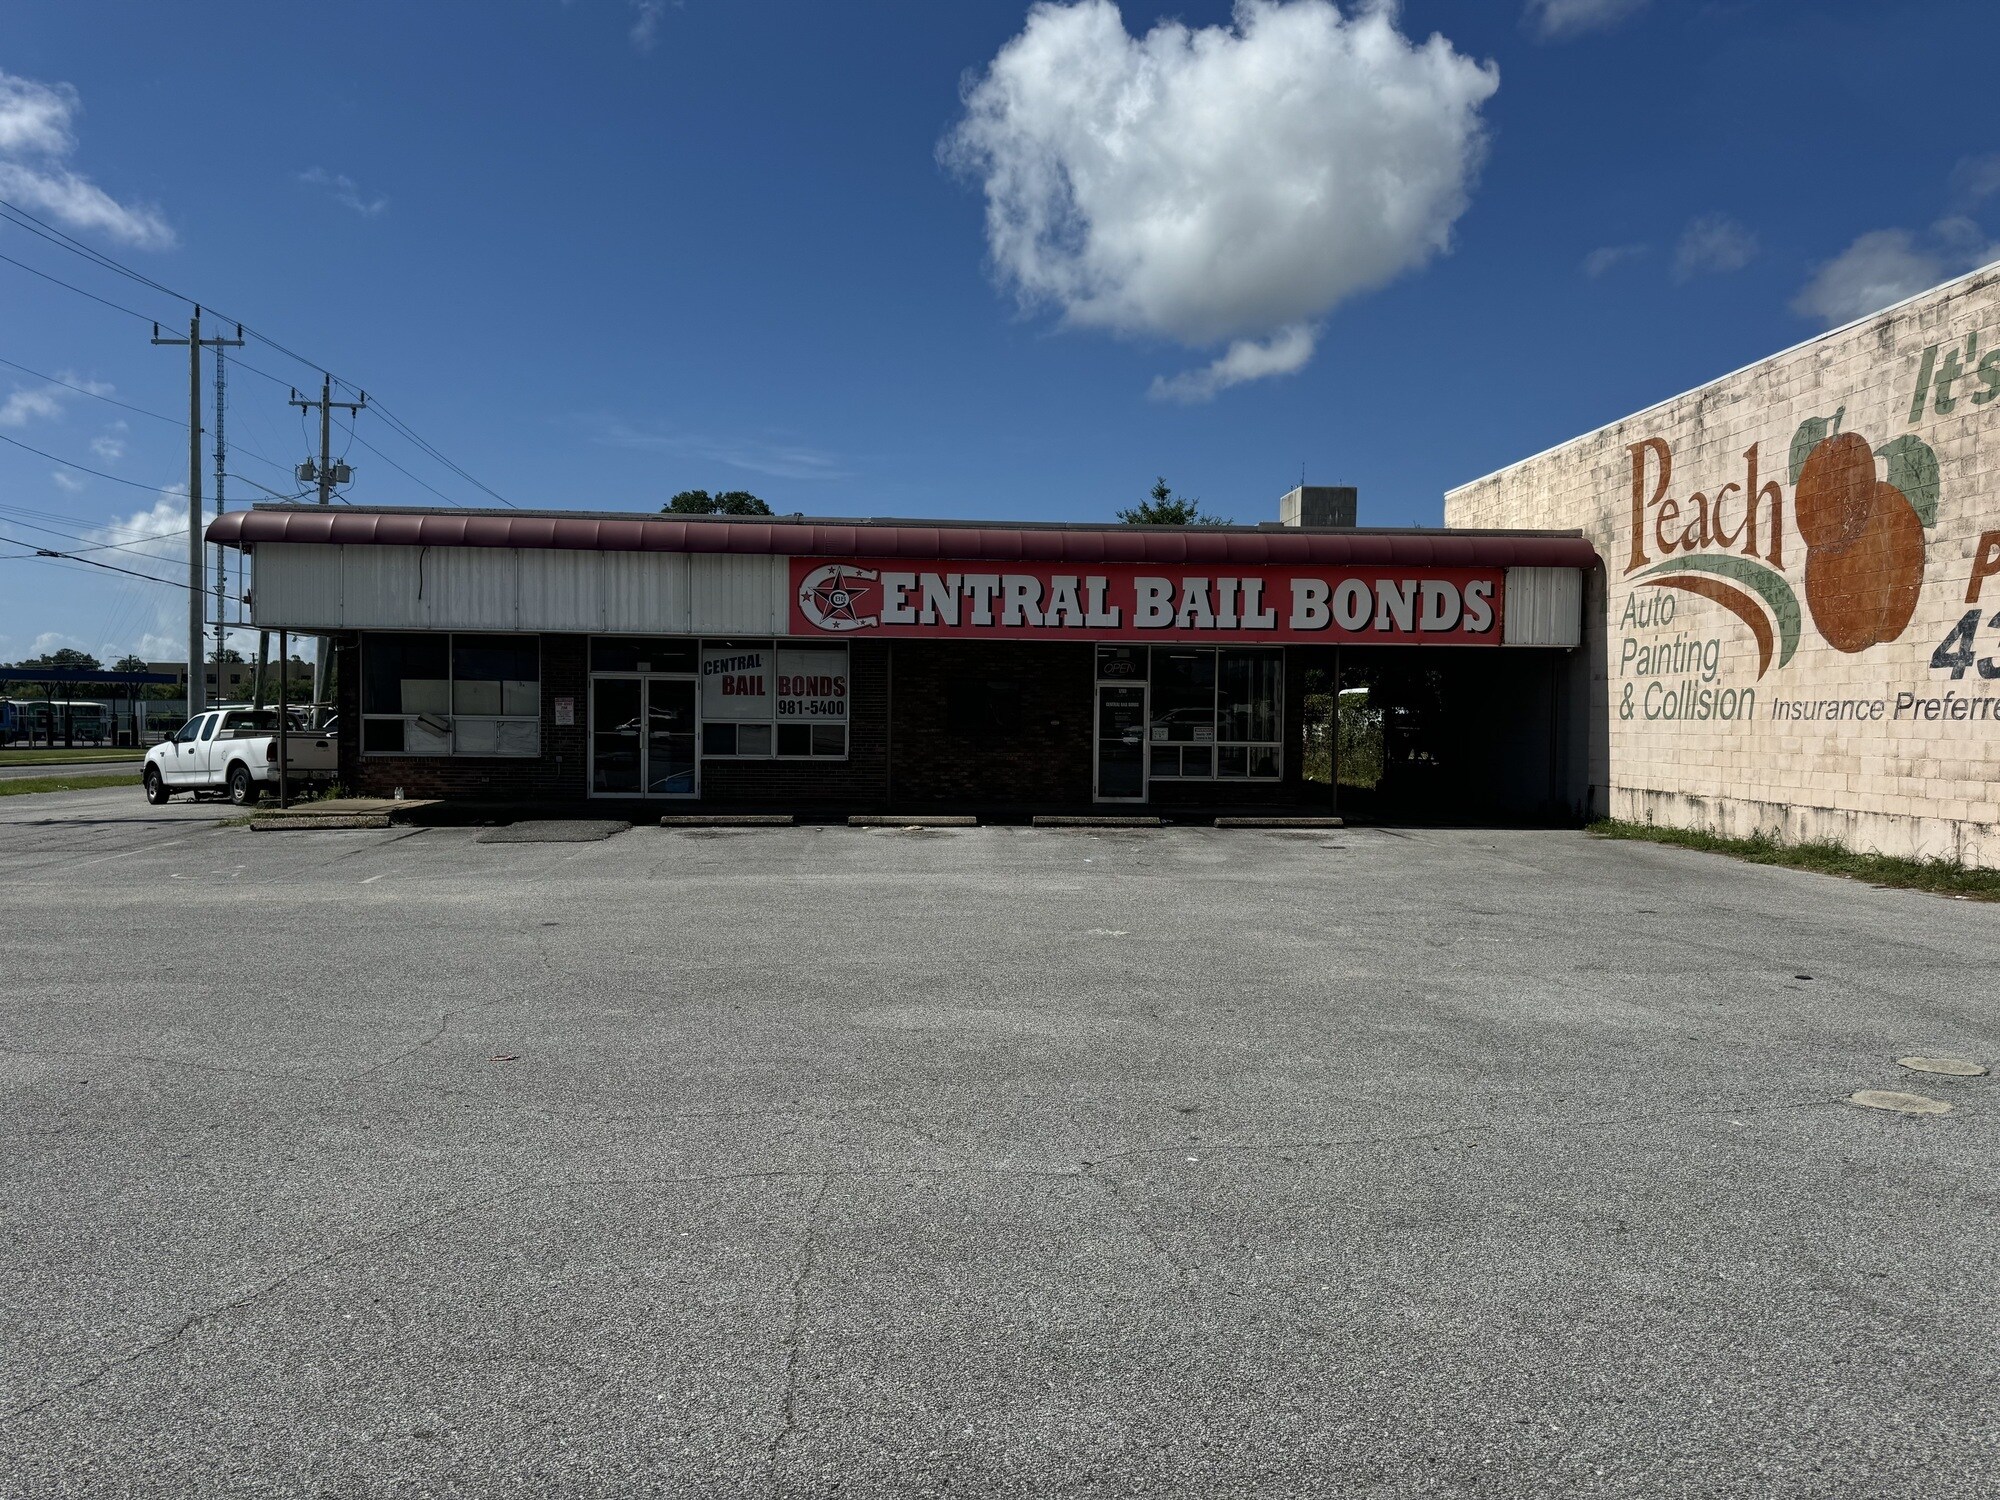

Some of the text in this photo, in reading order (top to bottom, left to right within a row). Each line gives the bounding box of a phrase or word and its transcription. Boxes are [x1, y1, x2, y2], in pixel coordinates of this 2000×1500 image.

[1623, 437, 1785, 577] Peach
[799, 564, 1493, 633] CENTRAL BAIL BONDS
[1620, 591, 1676, 631] Auto
[703, 653, 763, 676] CENTRAL
[1104, 662, 1136, 674] OPEN
[1620, 637, 1721, 683] Painting
[722, 675, 846, 697] BAIL BONDS
[1619, 678, 1755, 721] & Collision
[778, 700, 845, 715] 981-5400
[1771, 697, 1885, 721] Insurance
